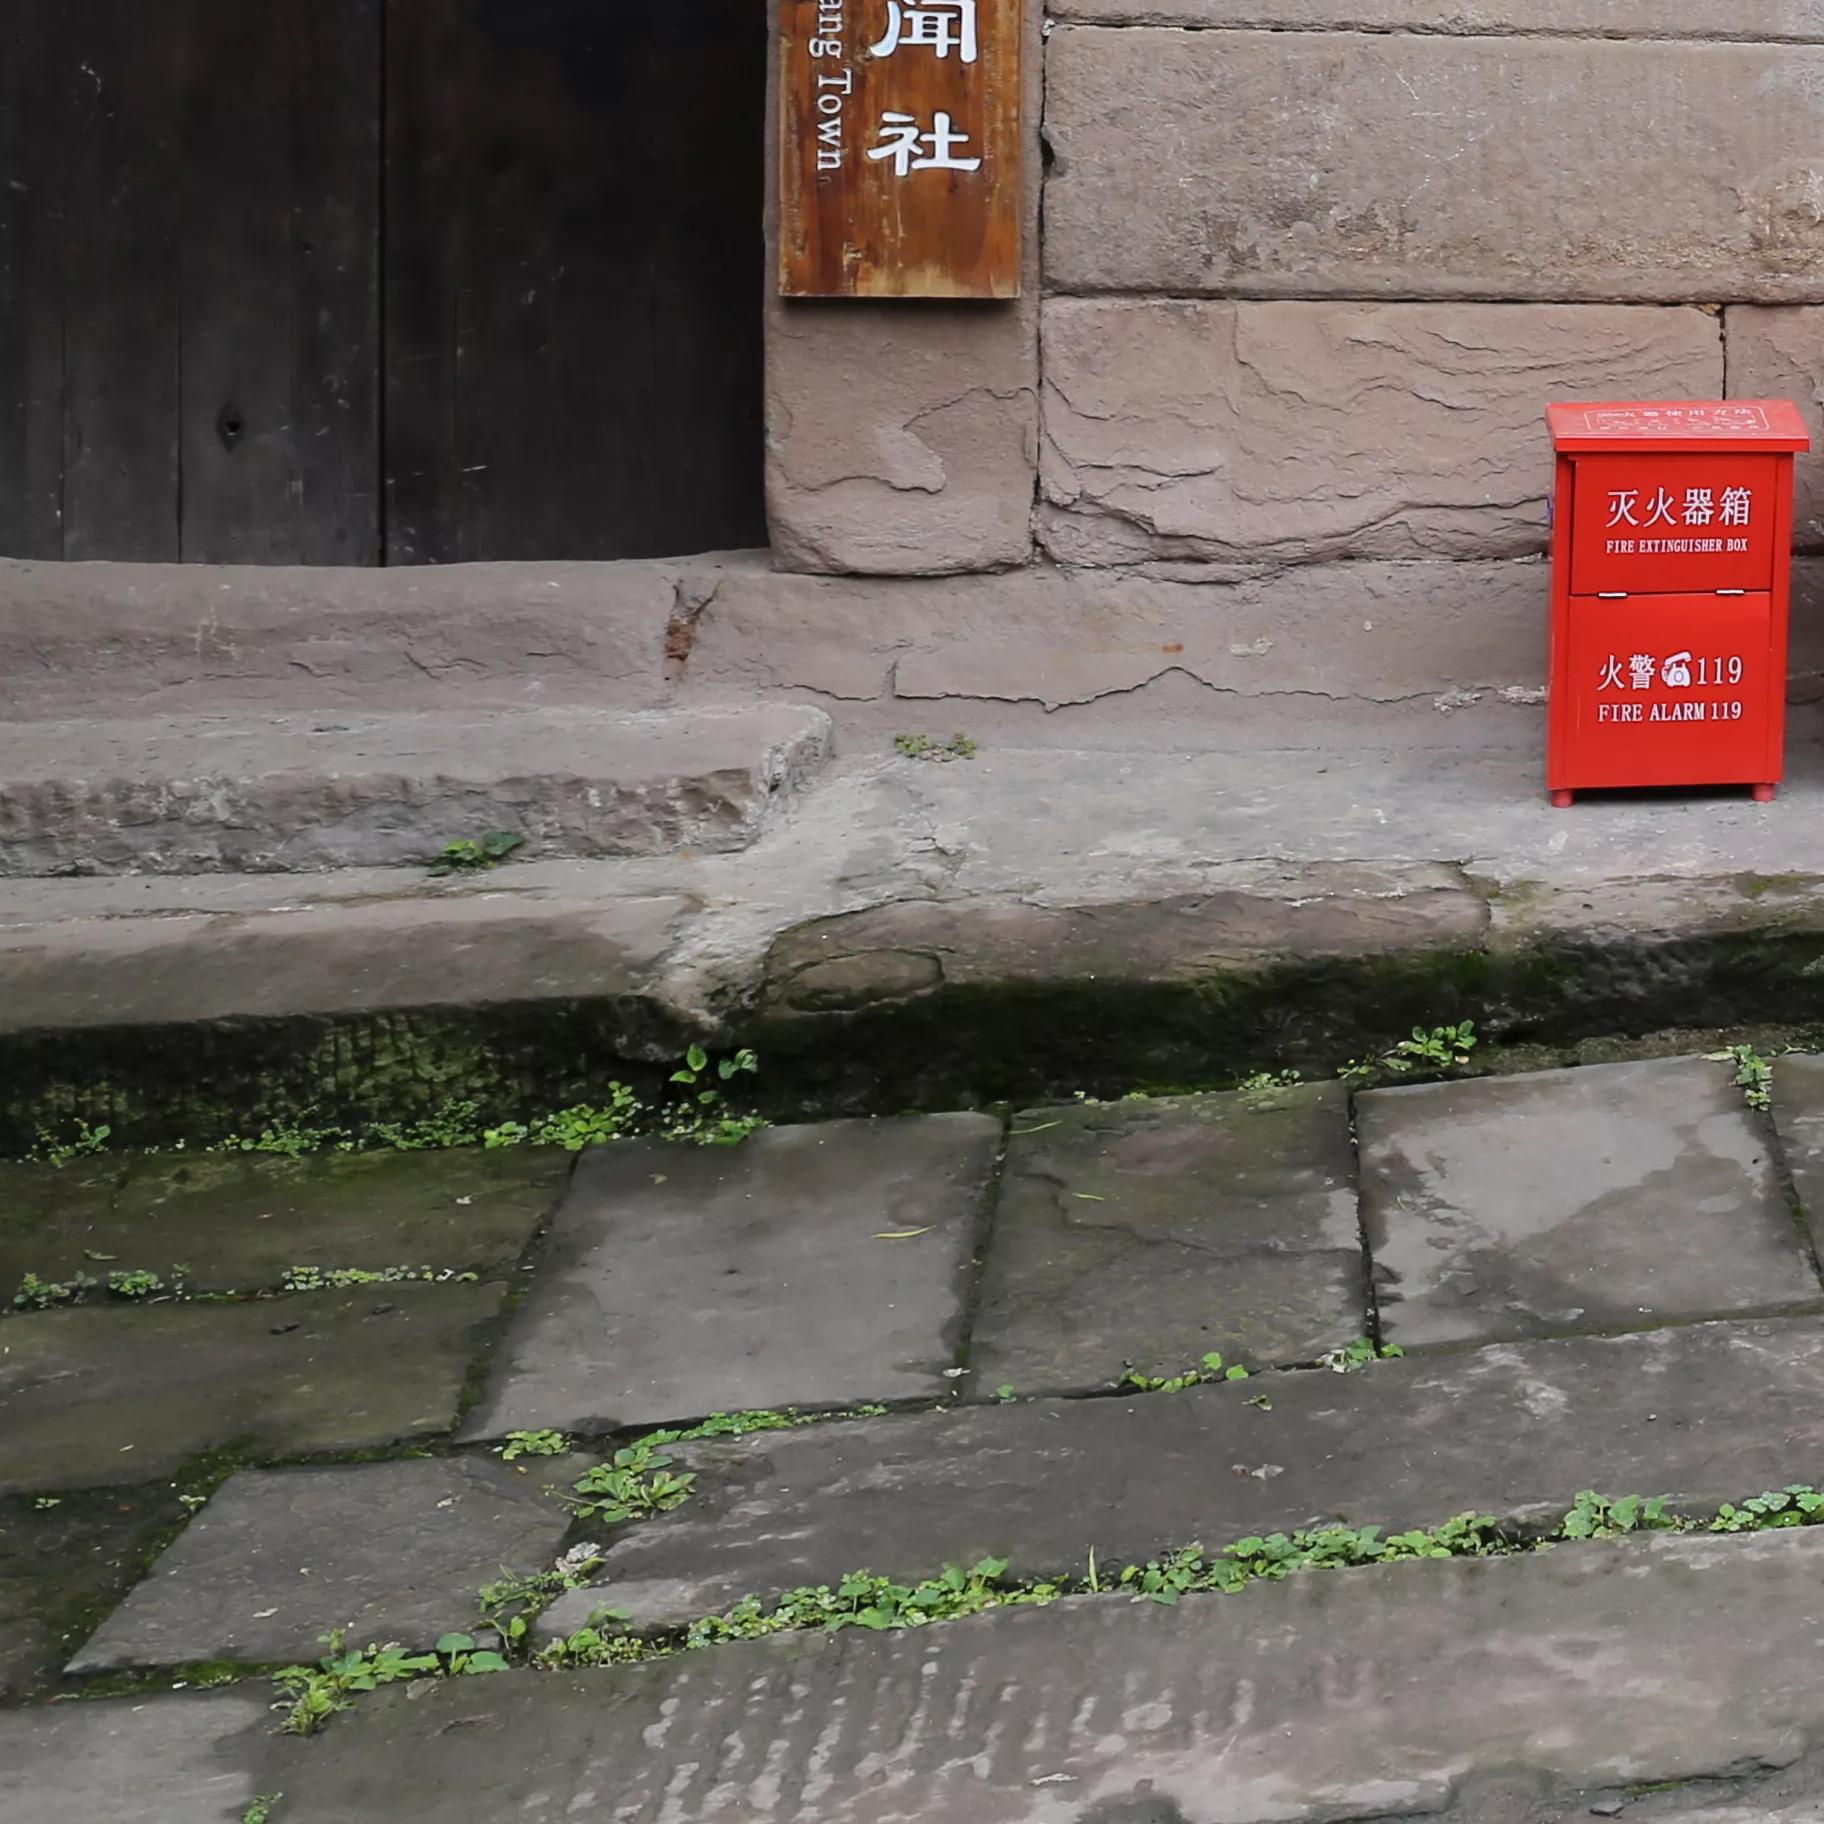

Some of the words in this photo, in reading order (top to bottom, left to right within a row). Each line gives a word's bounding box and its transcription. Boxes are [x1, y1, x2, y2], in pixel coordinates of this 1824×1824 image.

[816, 67, 853, 171] Town
[1605, 486, 1753, 528] 灭火器箱
[1606, 539, 1635, 555] FIRE
[1638, 538, 1723, 554] EXTINGUISHER
[1726, 537, 1749, 553] BOX
[1597, 654, 1656, 691] 火警
[1696, 655, 1743, 686] 119
[1598, 702, 1644, 723] FIRE
[1648, 701, 1706, 722] ALARM
[1710, 700, 1743, 721] 119
